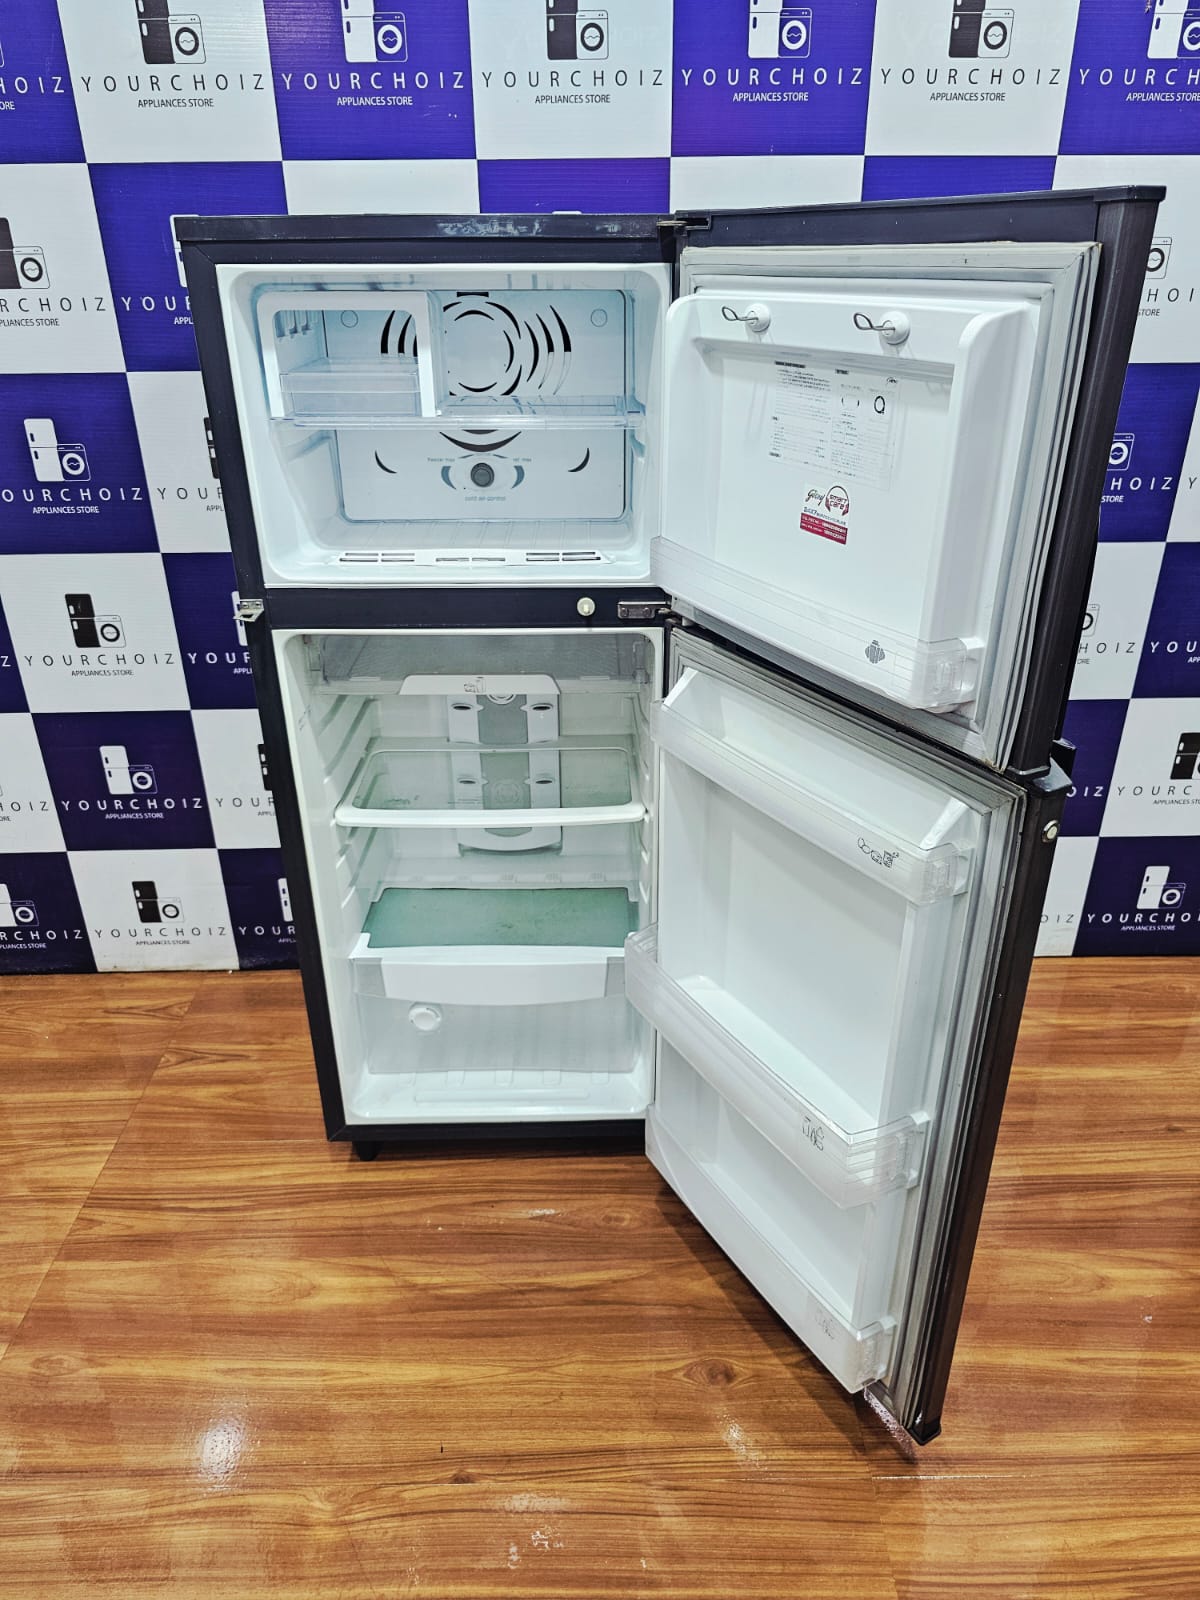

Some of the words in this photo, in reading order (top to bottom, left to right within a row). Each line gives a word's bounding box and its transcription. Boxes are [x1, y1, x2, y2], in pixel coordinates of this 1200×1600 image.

[282, 72, 463, 89] YOURCHOIZ
[482, 70, 662, 87] YOURCHOIZ
[682, 68, 862, 85] YOURCHOIZ
[881, 68, 1060, 84] YOURCHOIZ
[1080, 69, 1200, 85] YOURCH
[81, 74, 264, 92] YOURCHOIZ
[138, 98, 186, 107] APPLIANCES
[189, 98, 213, 107] STORE
[337, 96, 385, 105] APPLIANCES
[388, 96, 413, 105] STORE
[535, 94, 583, 103] APPLIANCES
[586, 94, 610, 103] STORE
[733, 92, 781, 101] APPLIANCES
[784, 92, 808, 101] STORE
[930, 93, 978, 102] APPLIANCES
[981, 93, 1005, 102] STORE
[1126, 93, 1174, 102] APPLIANCES
[1177, 93, 1200, 102] STORE
[36, 318, 59, 327] STORE
[1111, 477, 1172, 490] HOIZ
[2, 488, 142, 502] OURCHOIZ
[33, 506, 74, 514] APPLIANCES
[77, 506, 99, 514] STORE
[1151, 641, 1197, 653] YOU
[24, 654, 173, 666] YOURCHOIZ
[1118, 785, 1192, 796] YOURC
[62, 798, 202, 810] YOURCHOIZ
[95, 927, 225, 938] YOURCHOIZ
